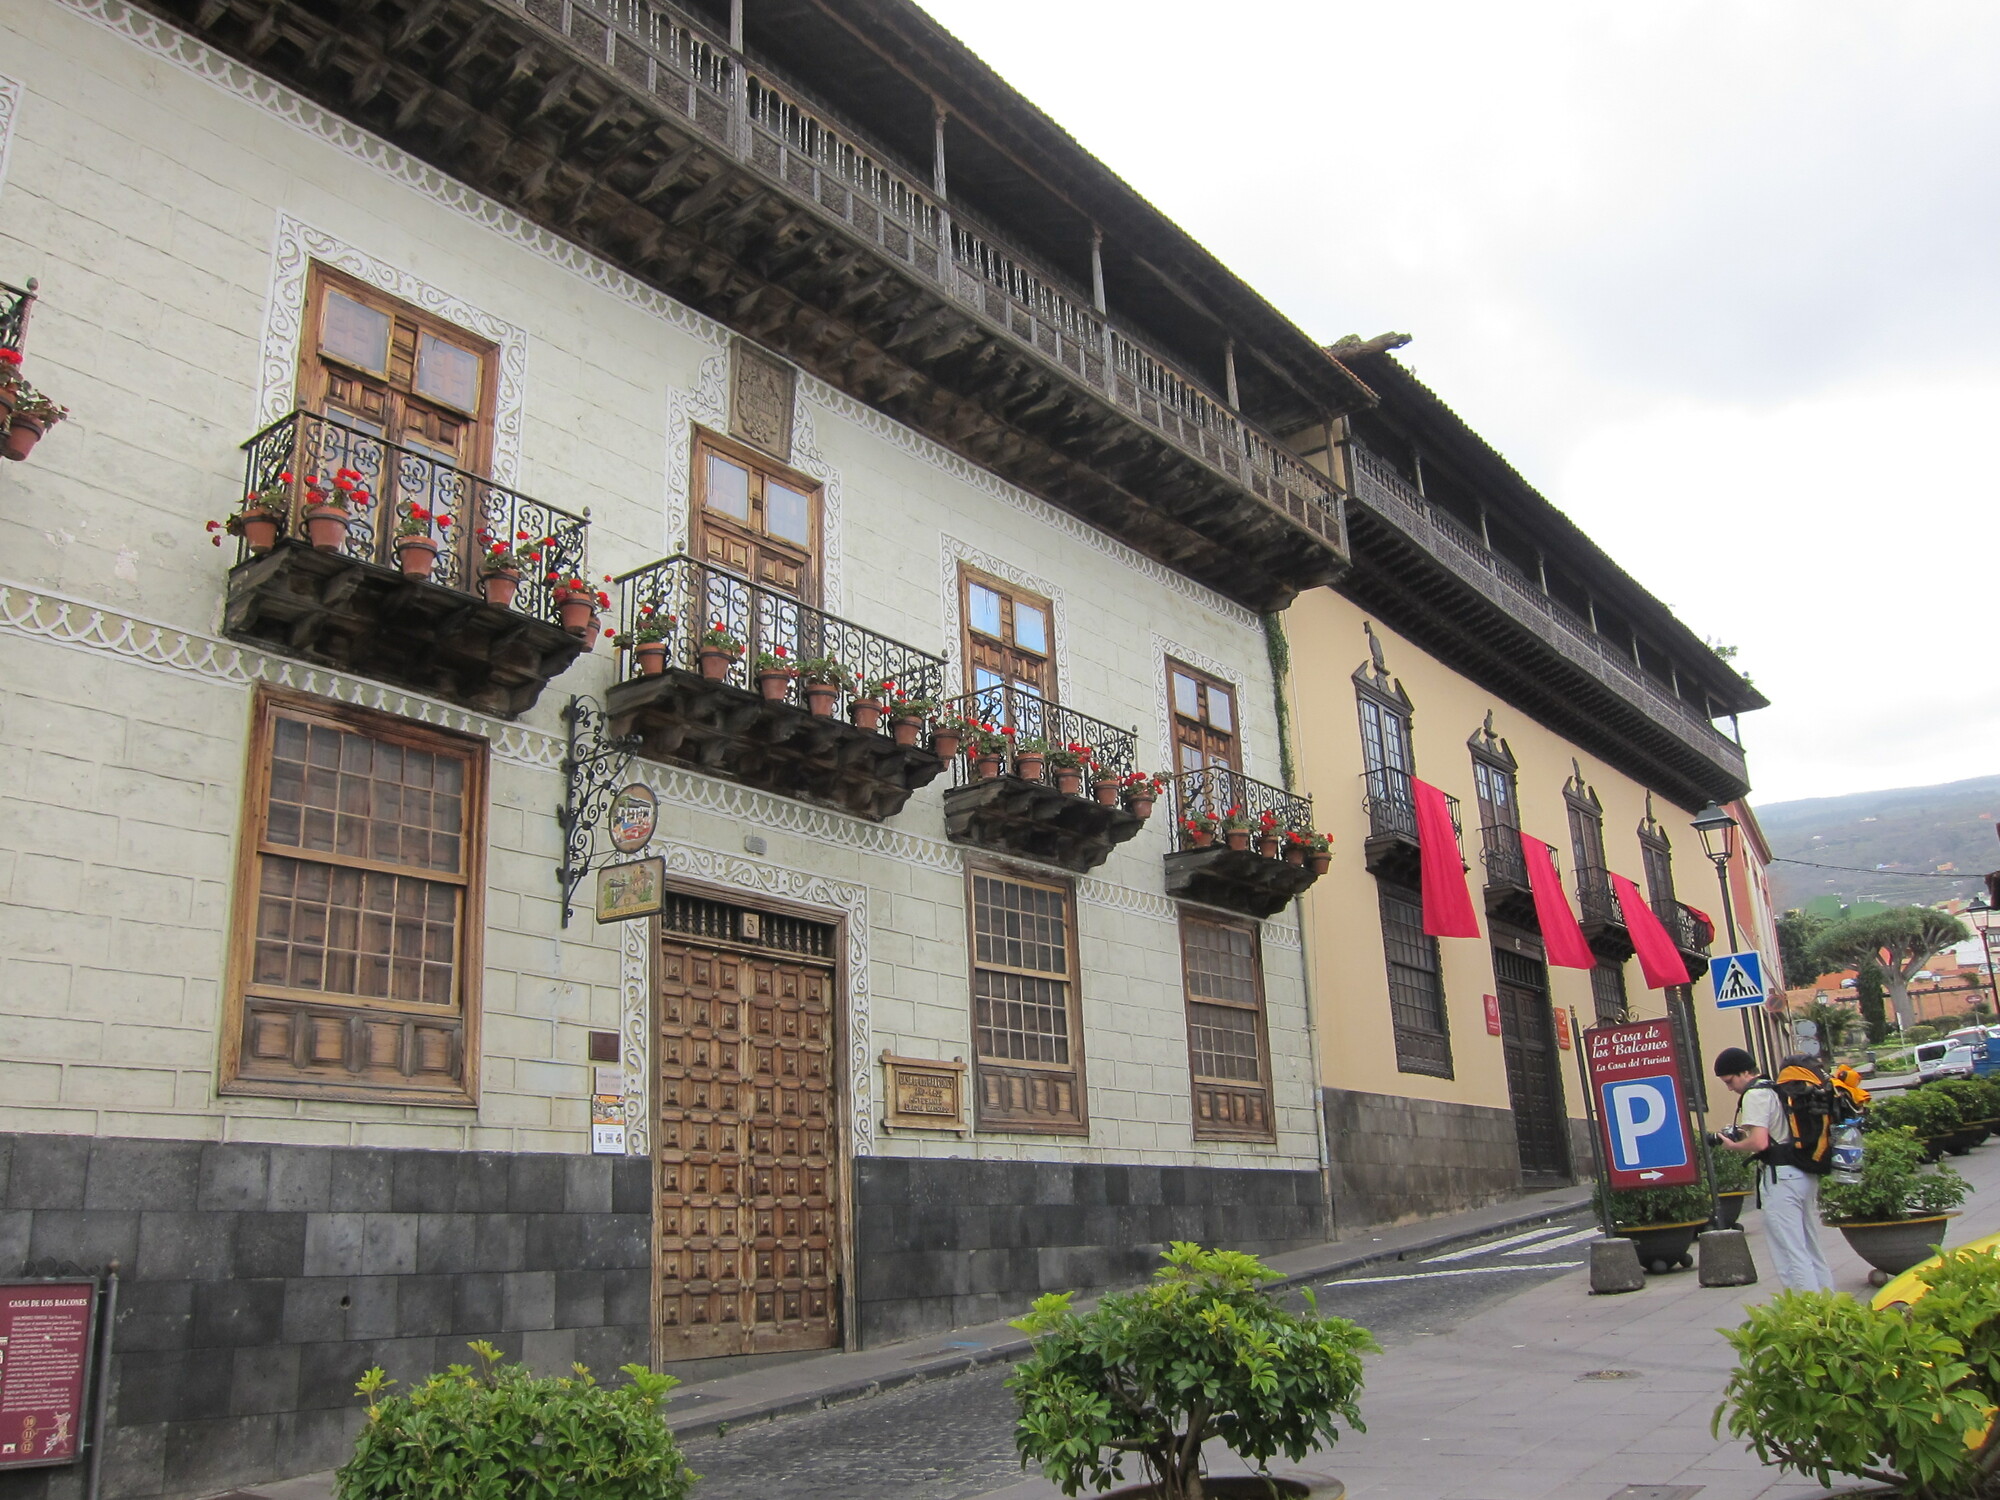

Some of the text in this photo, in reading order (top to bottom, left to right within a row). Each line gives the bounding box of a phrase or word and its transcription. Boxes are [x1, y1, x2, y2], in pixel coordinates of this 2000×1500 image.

[746, 917, 755, 935] 3
[1592, 1026, 1660, 1047] La Casa de
[1592, 1040, 1669, 1059] los Balcones
[1595, 1055, 1671, 1072] La Casa del Turista
[1612, 1084, 1666, 1165] P
[9, 1298, 88, 1308] CASAS DE LOS BALCONES
